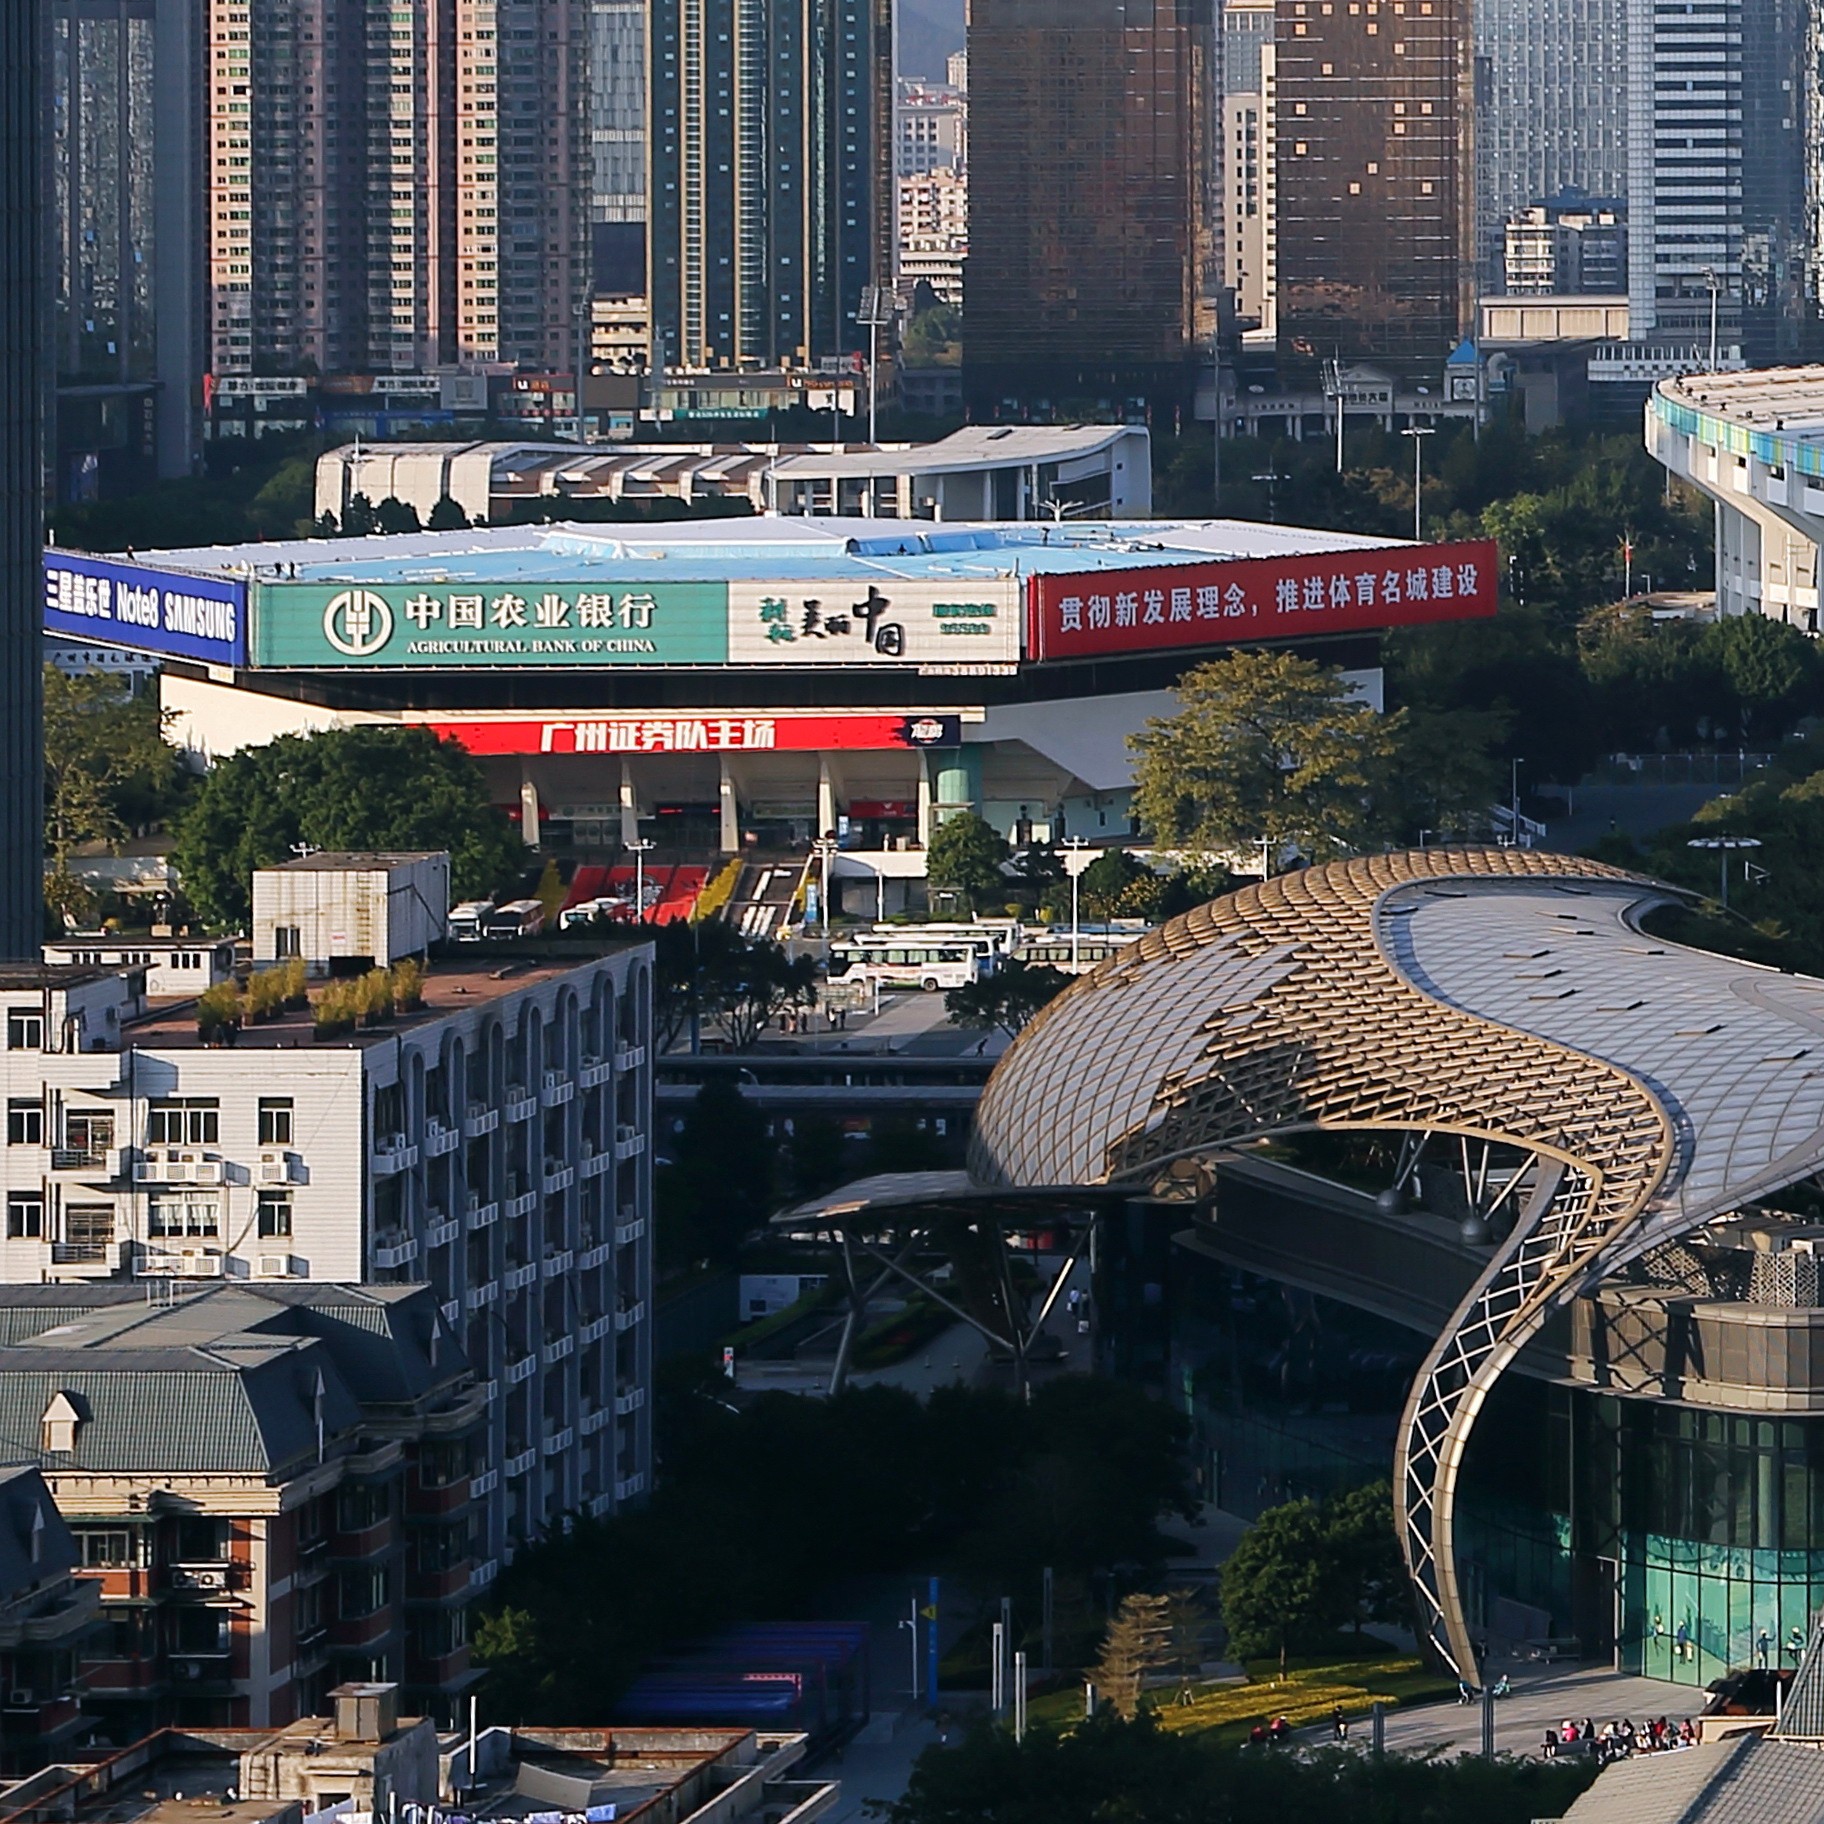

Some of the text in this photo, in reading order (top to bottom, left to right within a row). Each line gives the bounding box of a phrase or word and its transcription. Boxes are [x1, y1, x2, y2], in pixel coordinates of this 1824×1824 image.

[45, 569, 236, 643] 三星盖乐世 Note8 SAMSUNG
[405, 592, 656, 629] 中国农业银行
[1058, 562, 1478, 633] 贯彻新发展理念，推进体育名城建设
[406, 639, 656, 653] AGRICULTURAL BANK OF CHINA
[540, 719, 776, 753] 广州证券队主场
